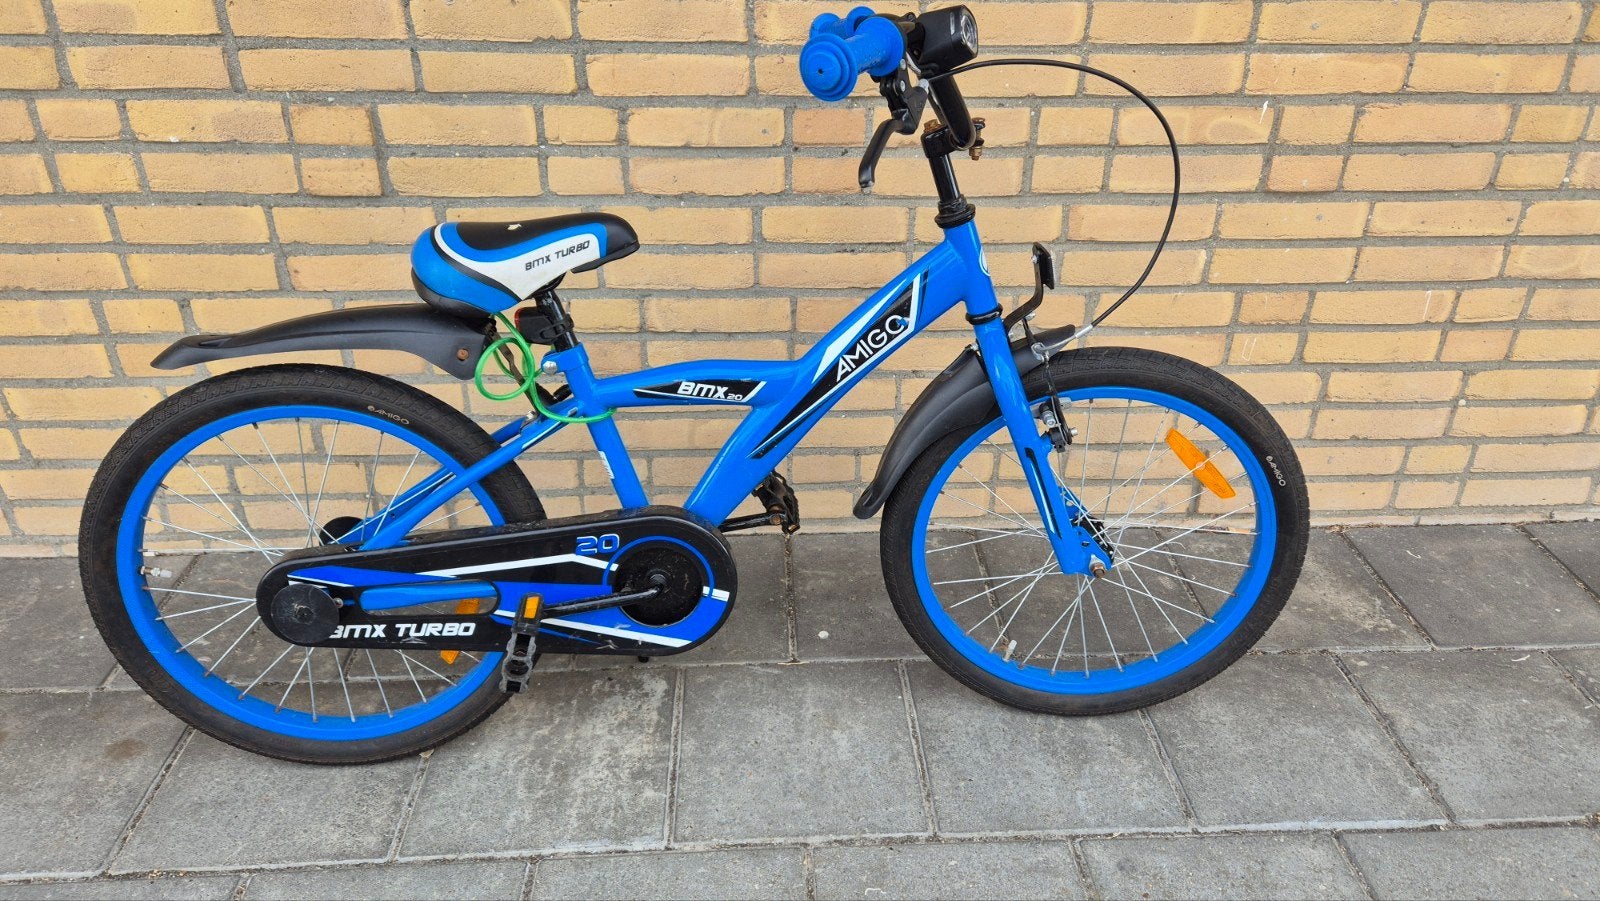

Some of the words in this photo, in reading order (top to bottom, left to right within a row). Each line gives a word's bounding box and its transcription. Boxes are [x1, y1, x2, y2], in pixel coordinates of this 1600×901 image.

[525, 254, 551, 271] BMX
[555, 240, 590, 259] TURBO
[836, 314, 906, 382] AMIGO
[677, 381, 728, 399] BMX
[727, 393, 743, 401] 20
[575, 534, 620, 556] 20
[395, 622, 476, 637] TURBO
